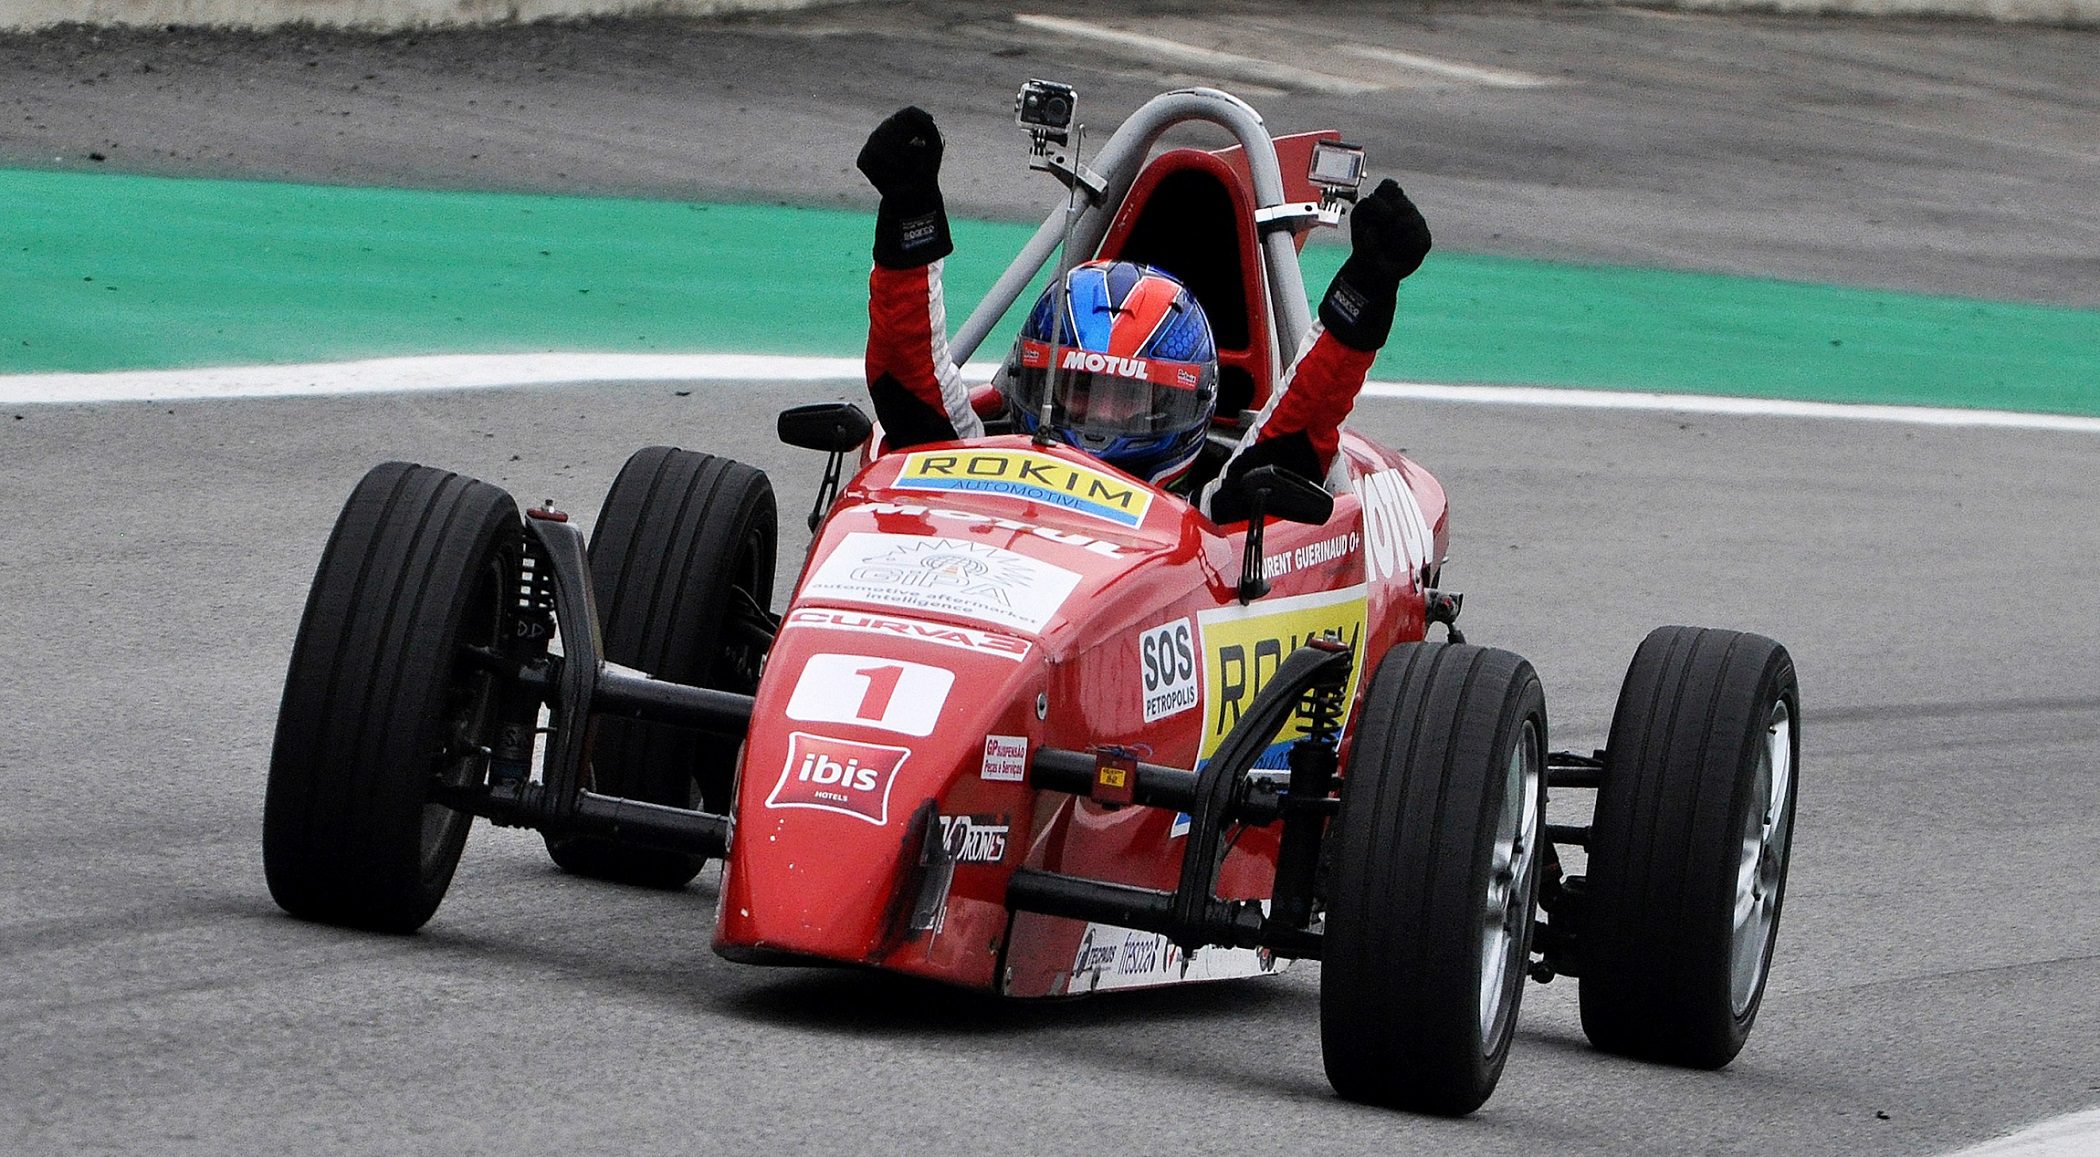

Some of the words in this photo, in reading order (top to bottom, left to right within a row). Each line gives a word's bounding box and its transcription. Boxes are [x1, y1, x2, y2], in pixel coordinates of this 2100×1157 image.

[1062, 351, 1149, 380] MOTUL
[919, 457, 1134, 509] ROKIM
[951, 478, 1086, 509] AUTOMOTIVE
[850, 503, 1125, 560] MOTUL
[1295, 534, 1348, 570] GUERINAUD
[812, 582, 920, 597] automotive
[926, 591, 1038, 624] aftermarket
[866, 592, 974, 614] intelligence
[790, 612, 1029, 655] CURVA3
[1144, 625, 1192, 691] SOS
[855, 665, 904, 722] 1
[1146, 686, 1195, 717] PETROPOLIS
[799, 753, 878, 791] ibis
[814, 790, 849, 802] HOTELS
